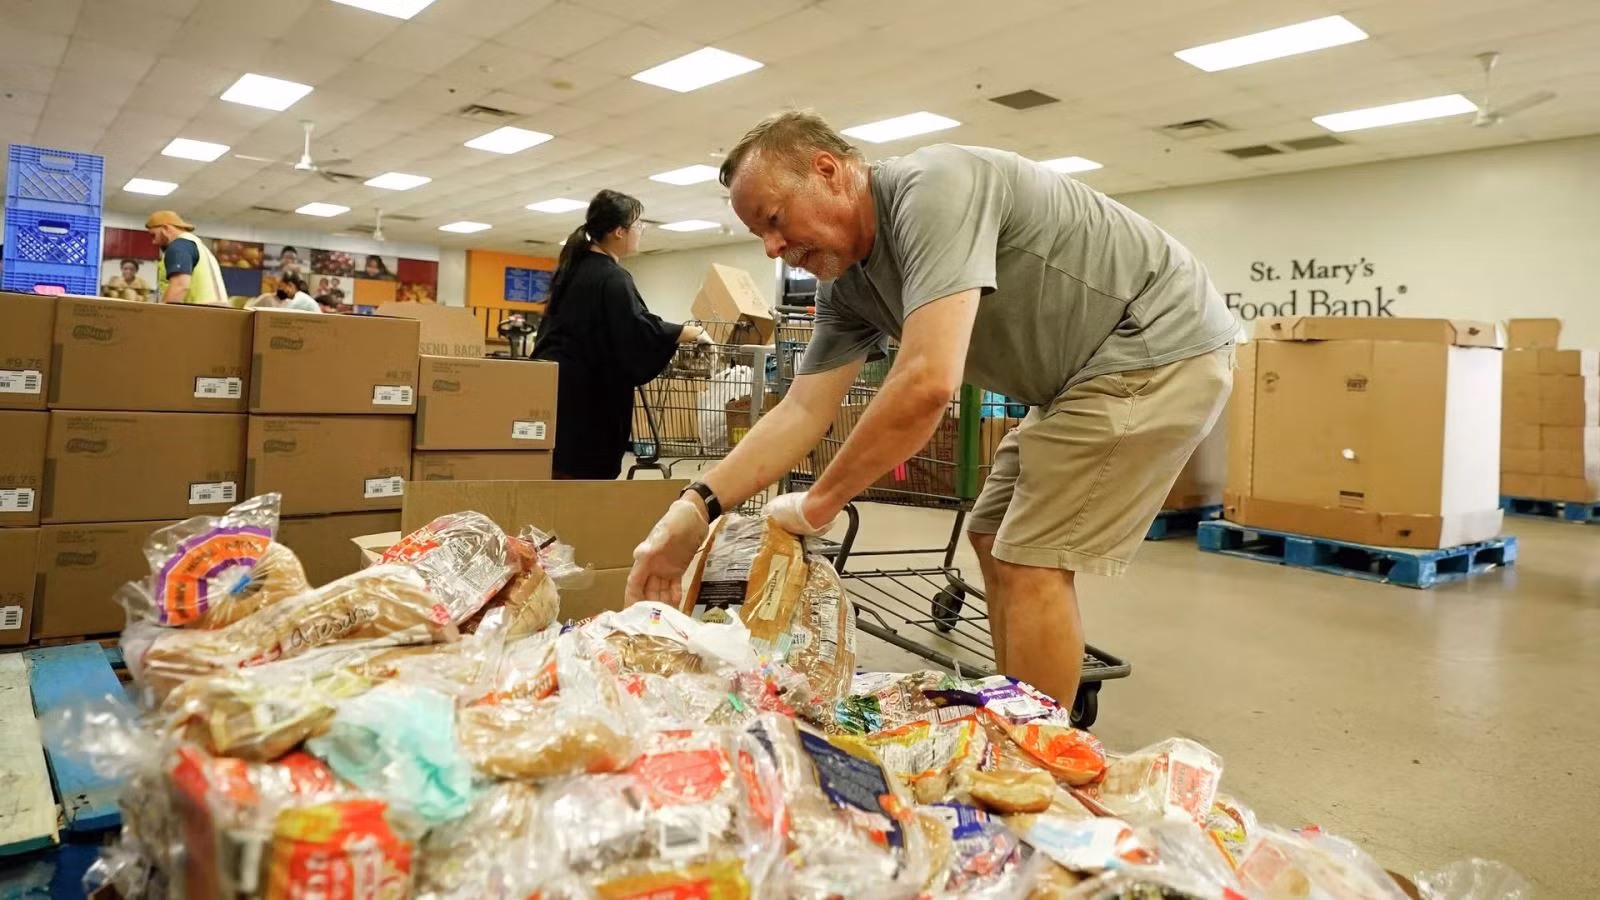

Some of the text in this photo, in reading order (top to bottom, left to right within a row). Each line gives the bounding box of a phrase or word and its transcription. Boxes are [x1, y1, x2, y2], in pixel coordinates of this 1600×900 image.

[1250, 256, 1375, 285] St. Mary's
[1224, 289, 1297, 321] Food
[420, 341, 483, 358] SEND BACK
